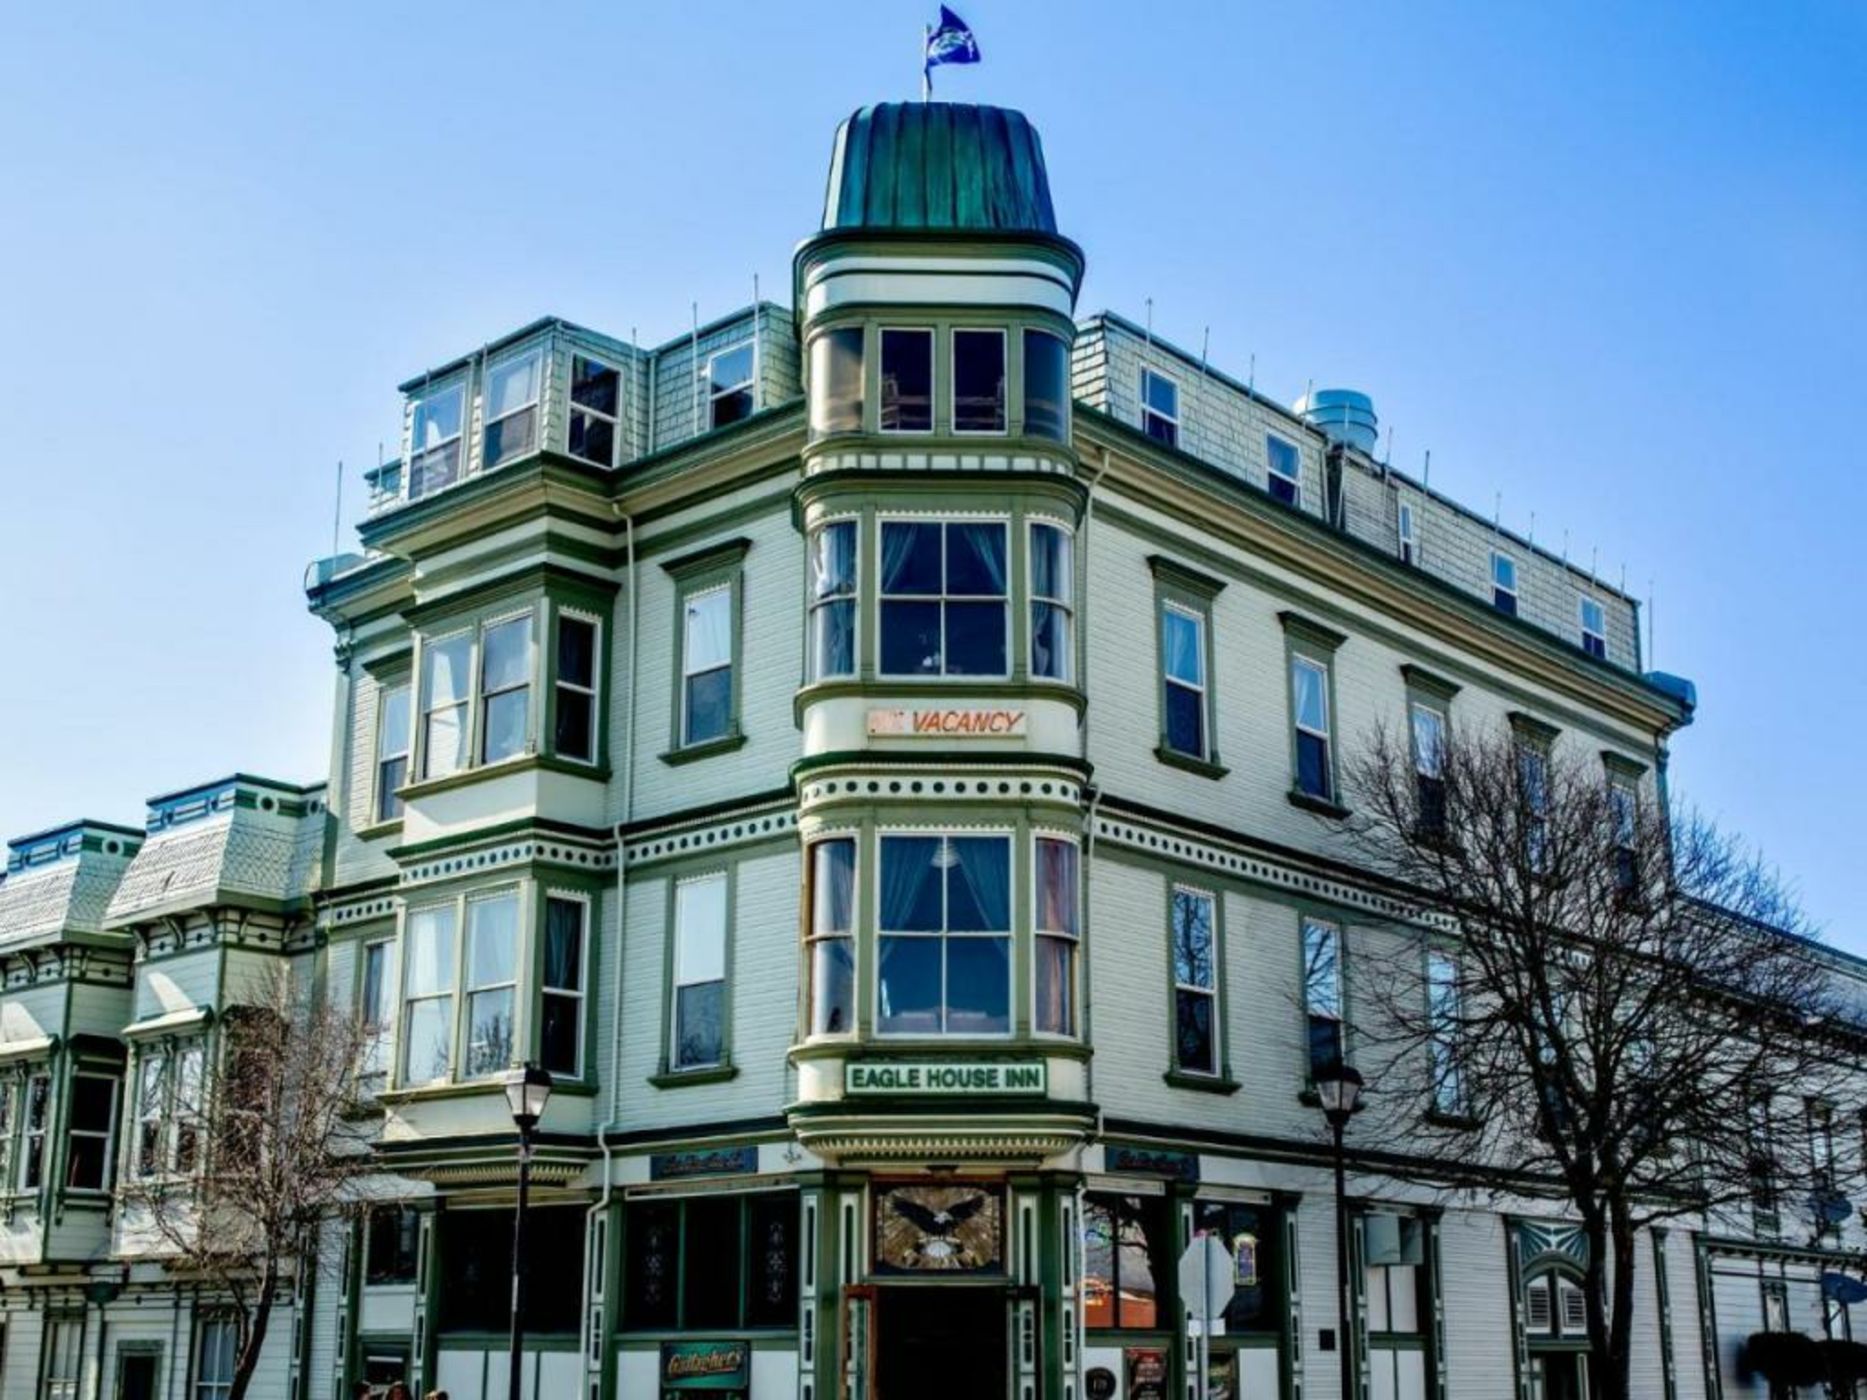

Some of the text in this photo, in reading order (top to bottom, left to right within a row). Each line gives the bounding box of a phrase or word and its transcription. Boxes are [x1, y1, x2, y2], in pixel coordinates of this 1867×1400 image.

[912, 711, 1024, 732] VACANCY
[852, 1068, 1040, 1088] EAGLE HOUSE INN
